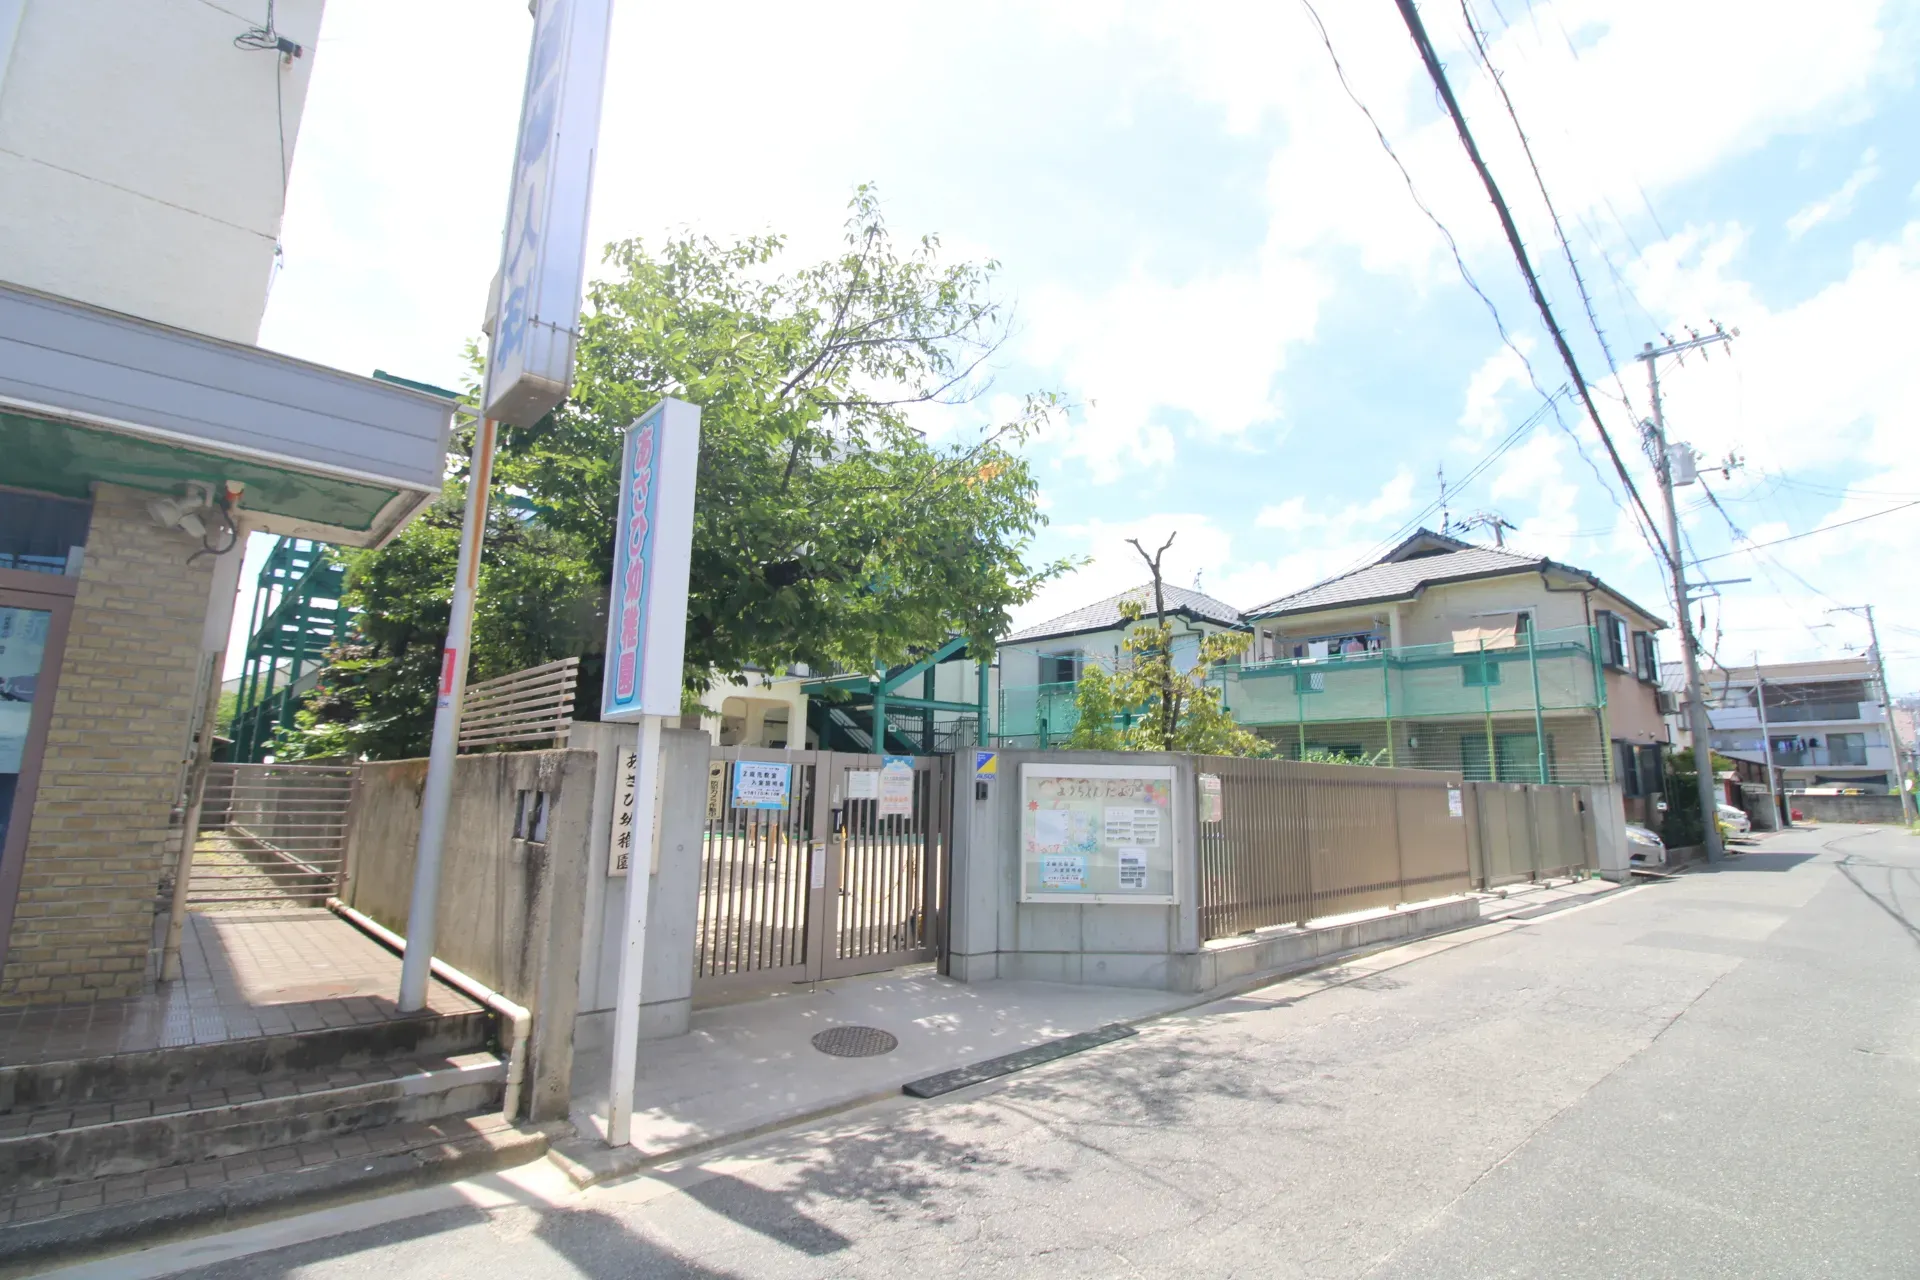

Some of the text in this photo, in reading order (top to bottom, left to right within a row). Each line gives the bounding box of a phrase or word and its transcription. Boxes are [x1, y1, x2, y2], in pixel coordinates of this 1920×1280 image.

[616, 423, 653, 697] あさひ幼稚園
